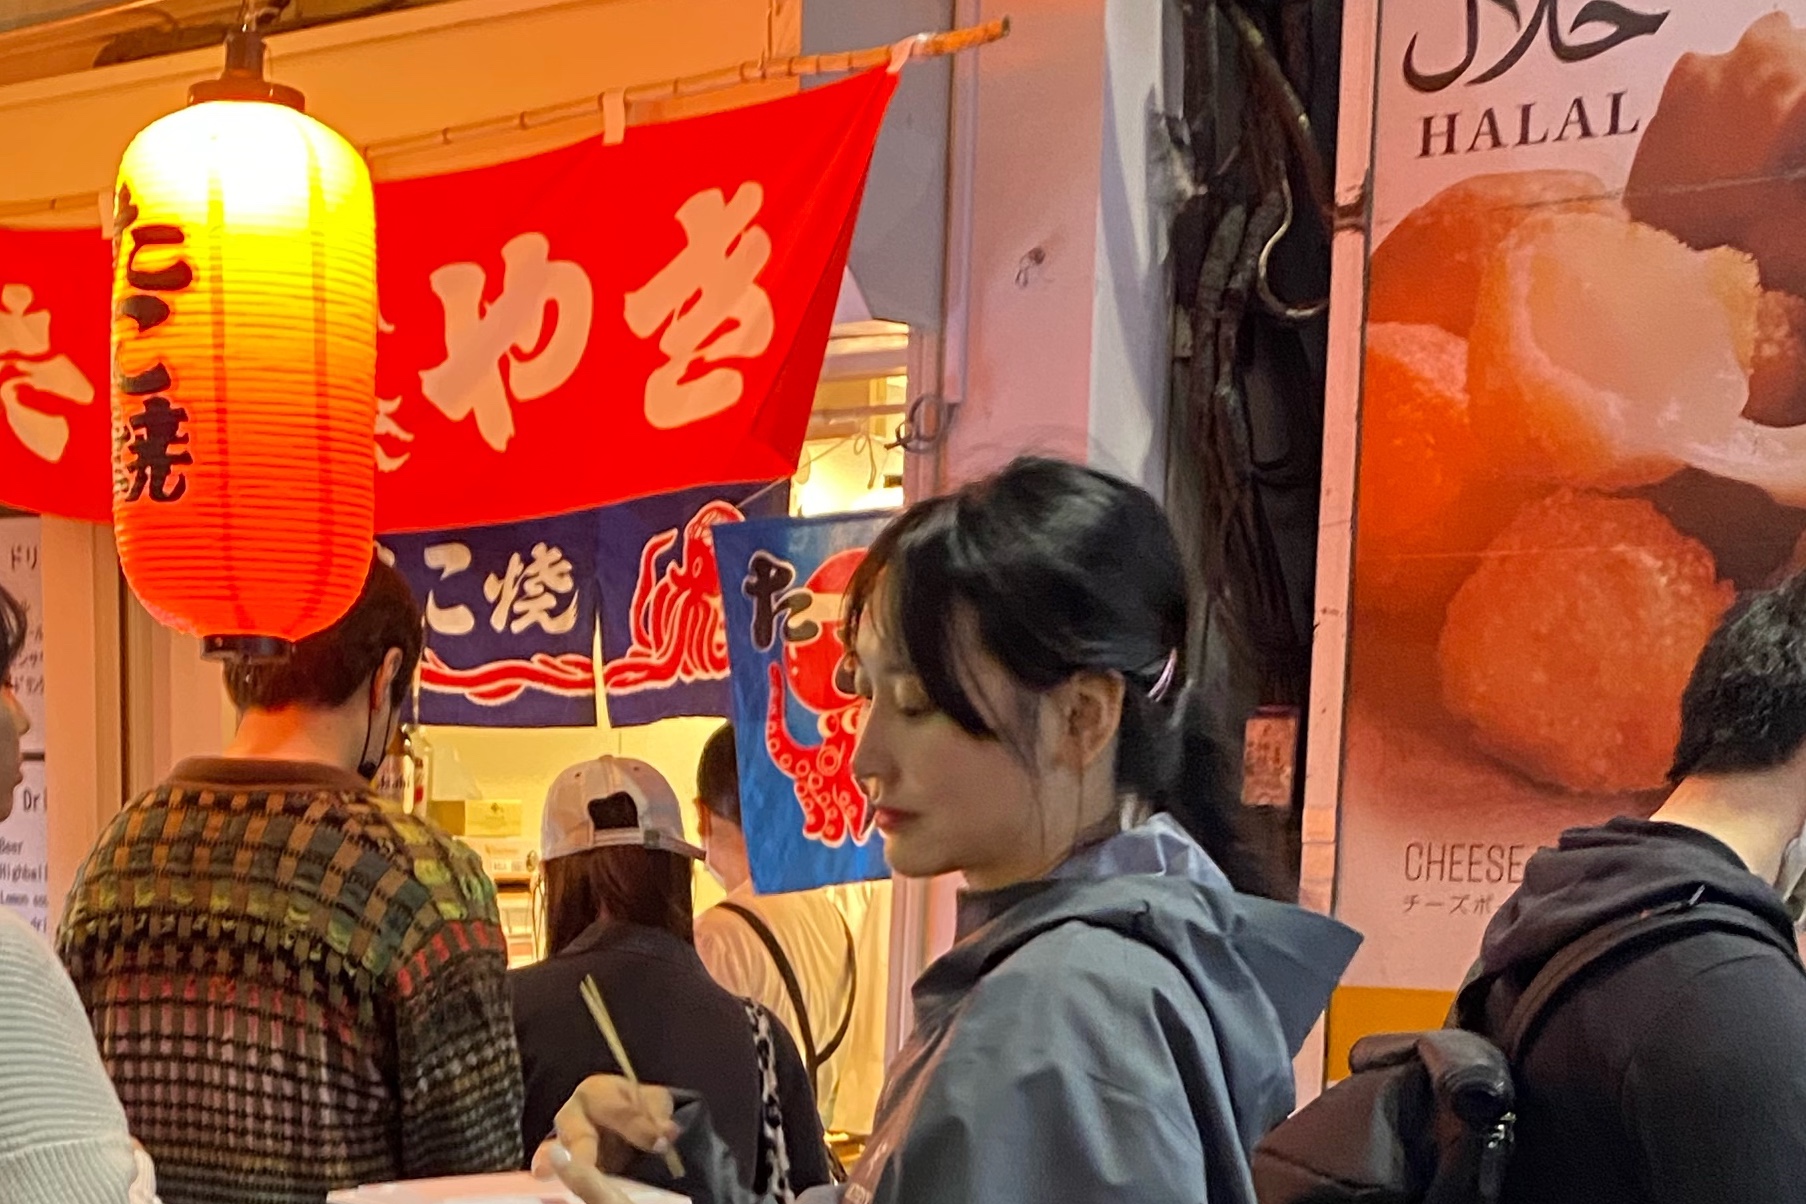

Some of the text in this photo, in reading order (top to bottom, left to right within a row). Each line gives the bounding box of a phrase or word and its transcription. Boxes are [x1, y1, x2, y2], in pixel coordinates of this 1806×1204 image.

[1416, 89, 1641, 159] HALAL
[374, 541, 580, 637] こ焼
[1405, 842, 1525, 884] CHEESE
